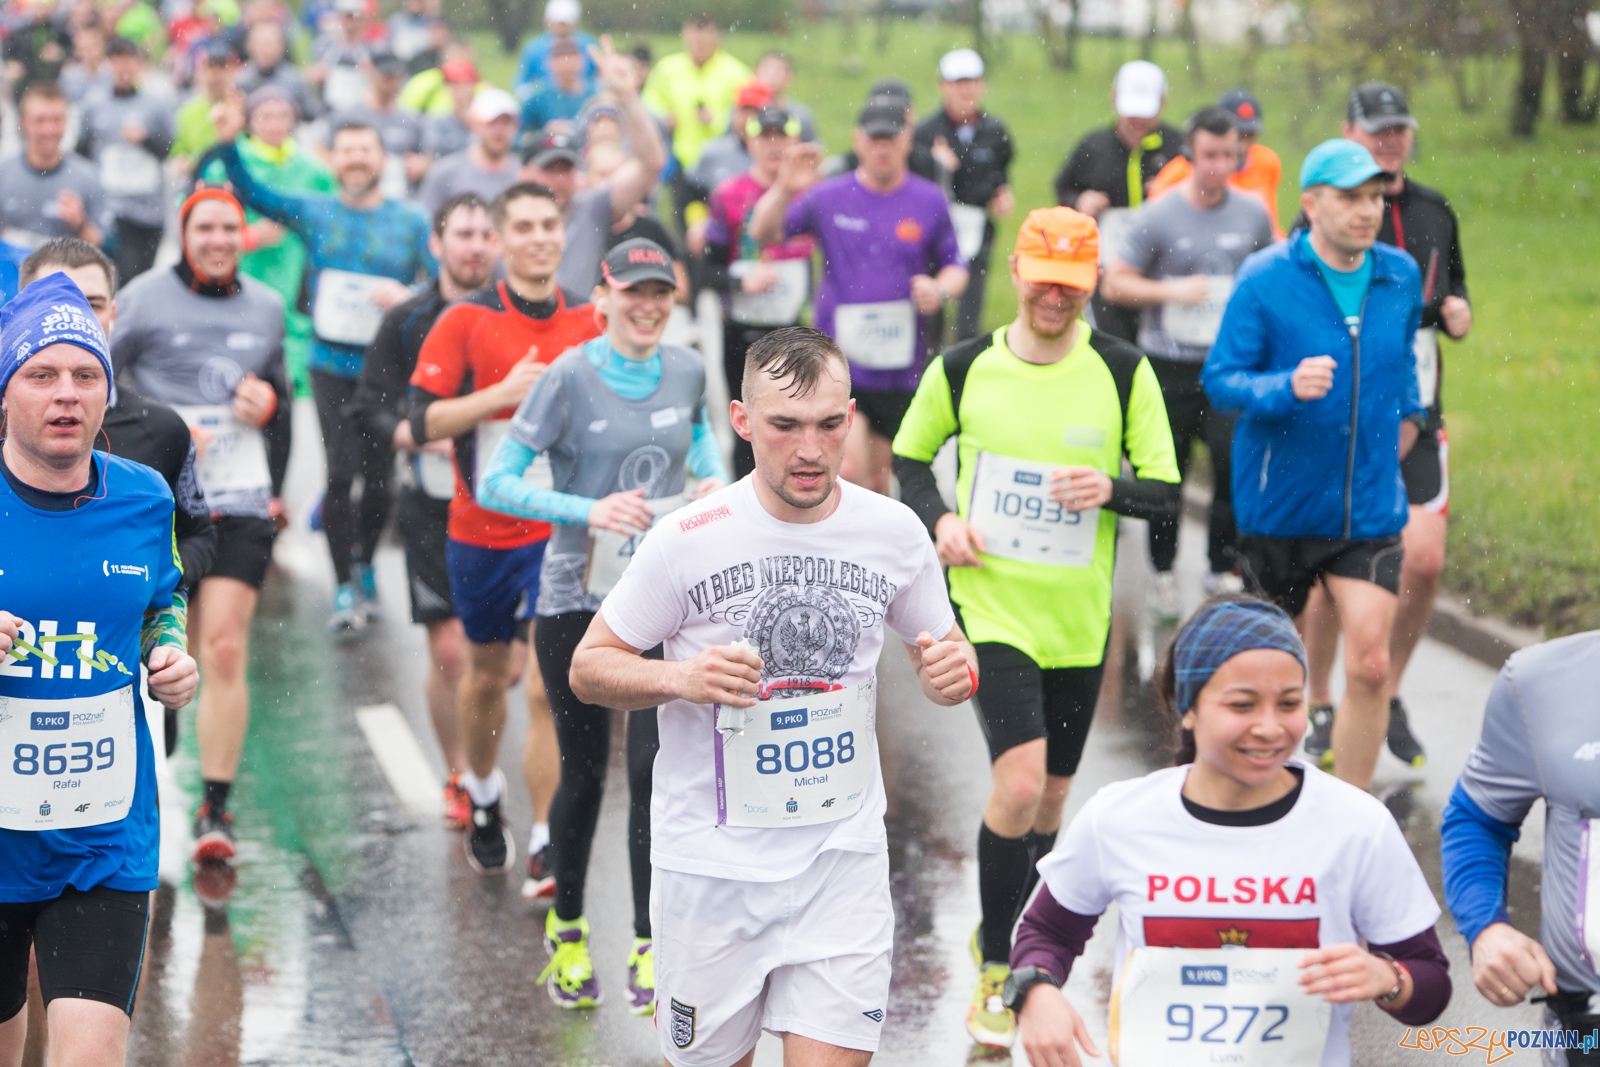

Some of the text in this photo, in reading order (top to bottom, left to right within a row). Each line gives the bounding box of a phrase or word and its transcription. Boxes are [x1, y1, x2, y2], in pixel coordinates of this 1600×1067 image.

[688, 578, 711, 614] VI
[710, 561, 756, 605] BIEG
[36, 717, 65, 726] 9.PKO
[776, 715, 803, 725] 9.PKO
[13, 736, 115, 776] 8639
[756, 731, 855, 774] 8088
[53, 779, 81, 790] Rafał
[794, 774, 828, 787] Michał
[1147, 875, 1317, 905] POLSKA
[1166, 1003, 1290, 1044] 9272
